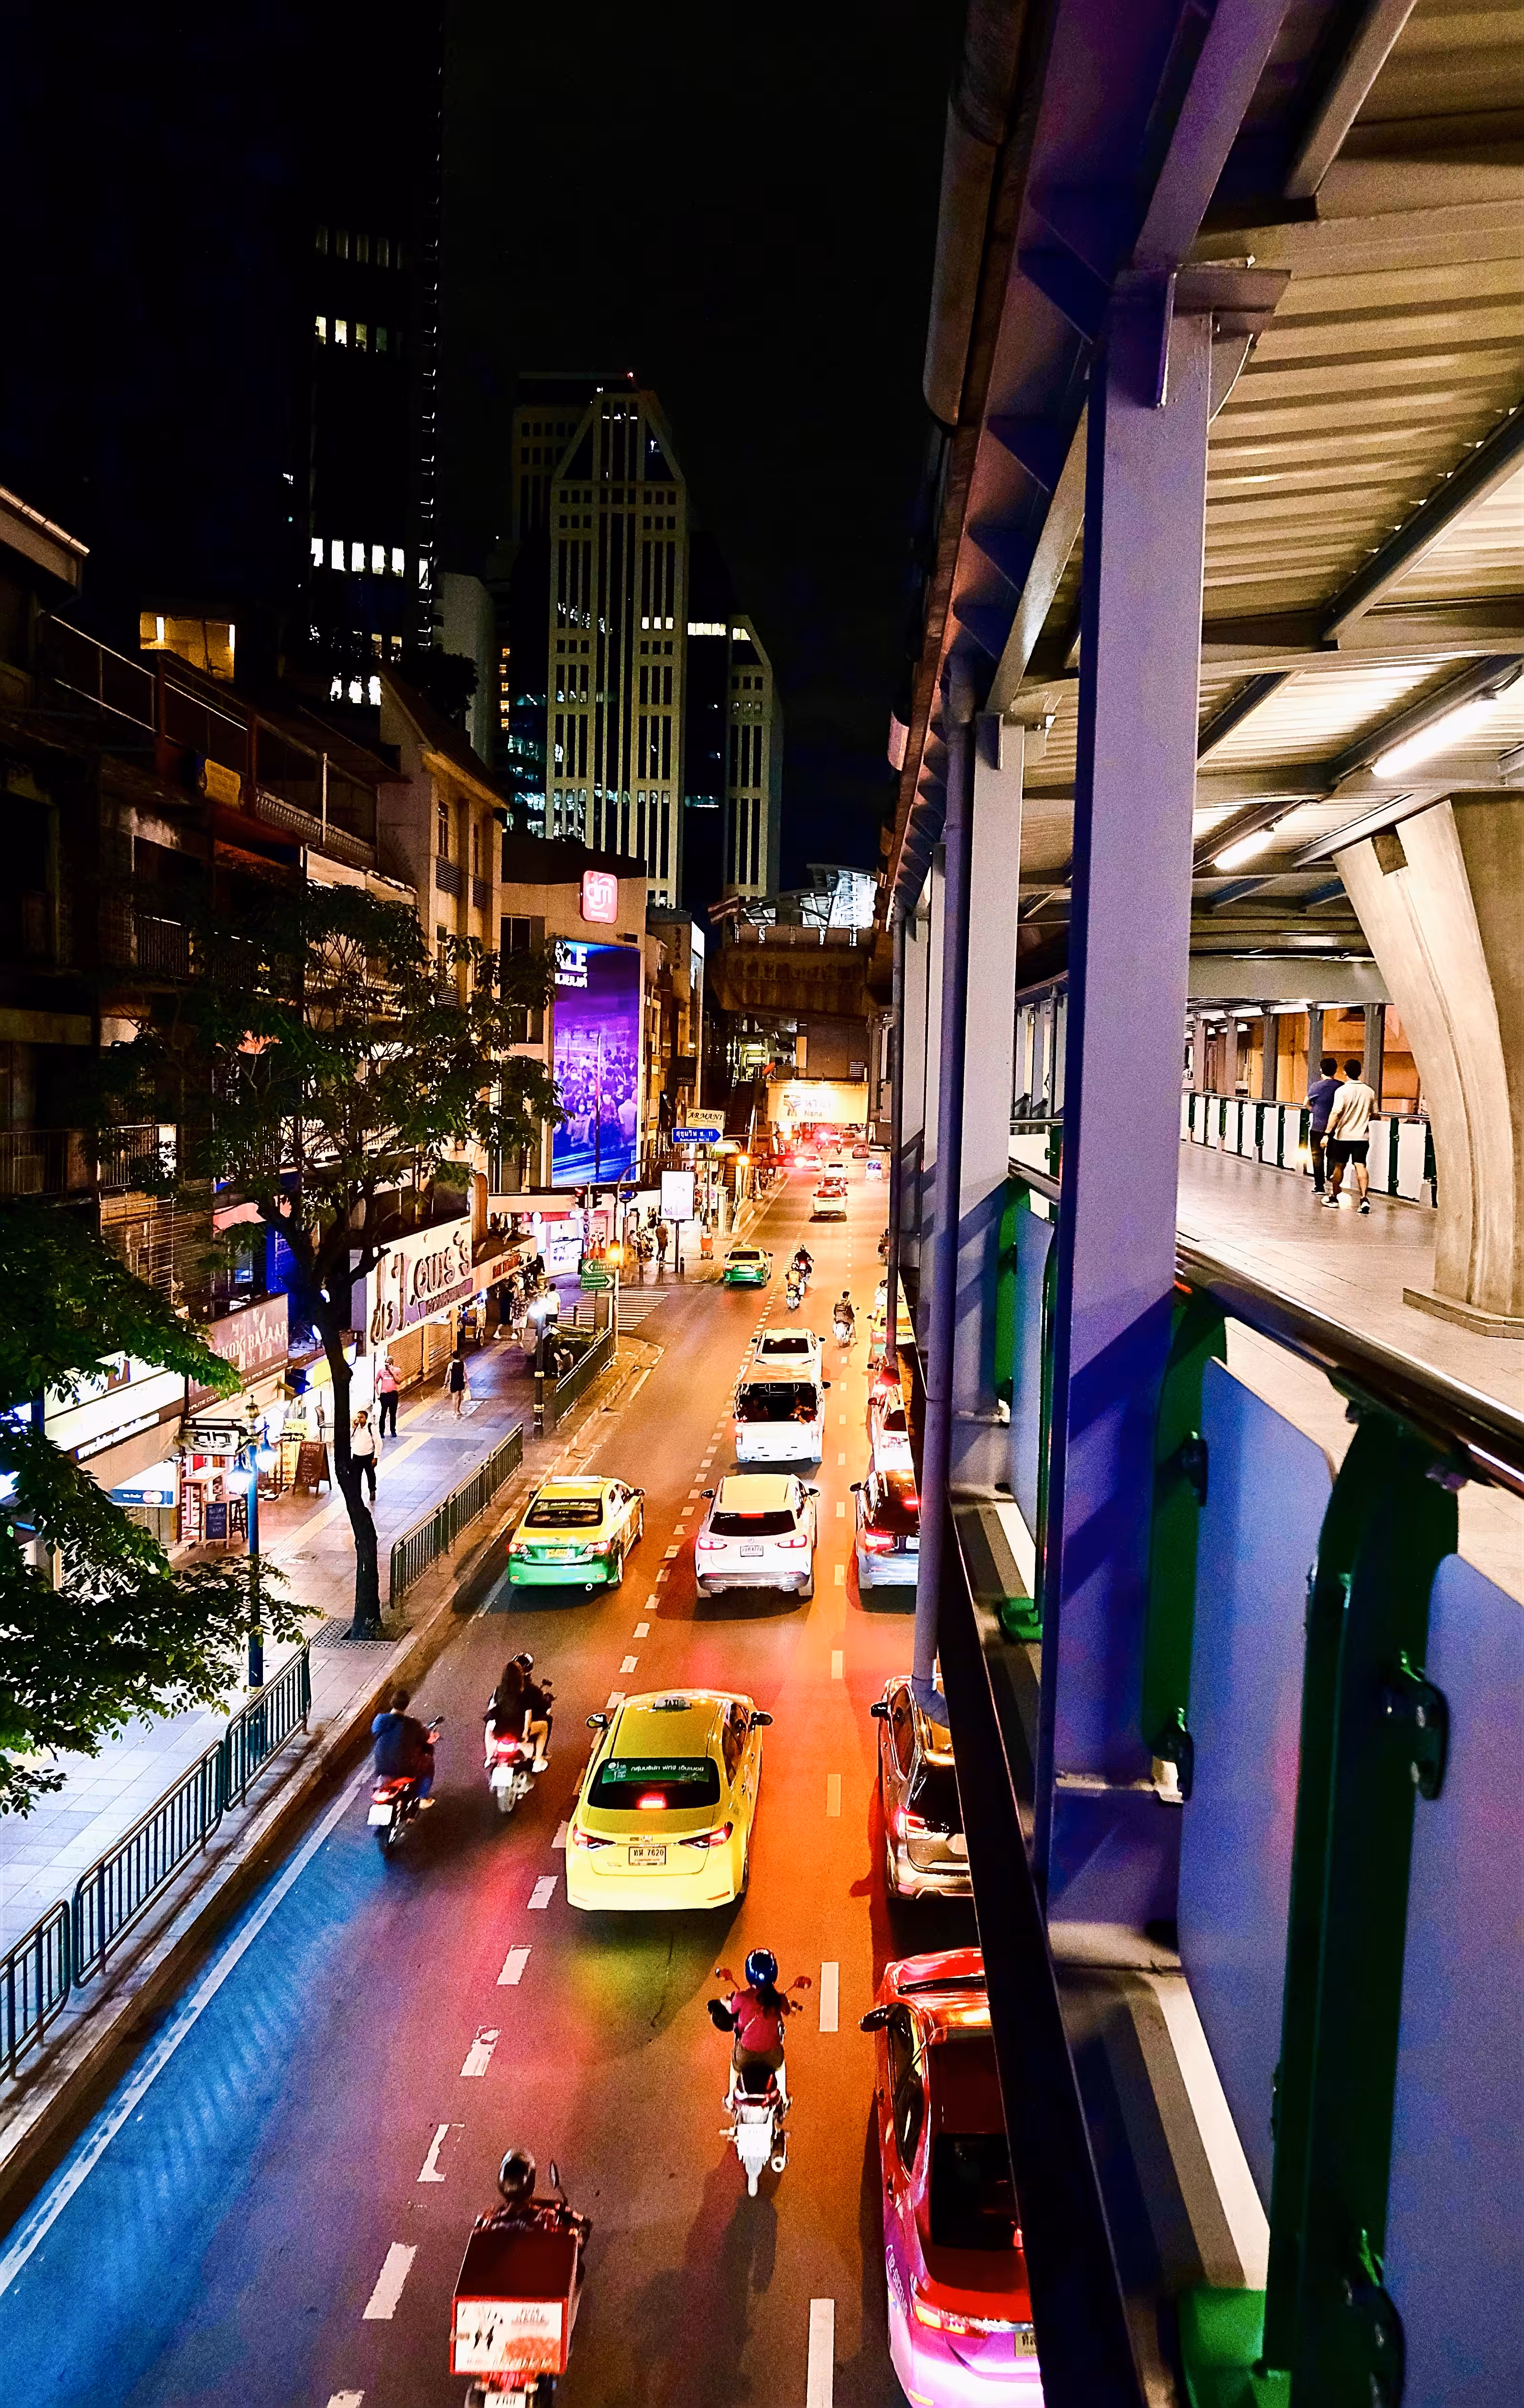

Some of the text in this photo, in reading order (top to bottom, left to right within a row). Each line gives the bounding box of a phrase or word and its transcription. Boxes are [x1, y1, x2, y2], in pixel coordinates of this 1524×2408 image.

[687, 1112, 723, 1120] ARMANI
[805, 1109, 823, 1117] Nana
[676, 1130, 697, 1138] สุขุมวิท
[207, 1392, 220, 1402] COUT
